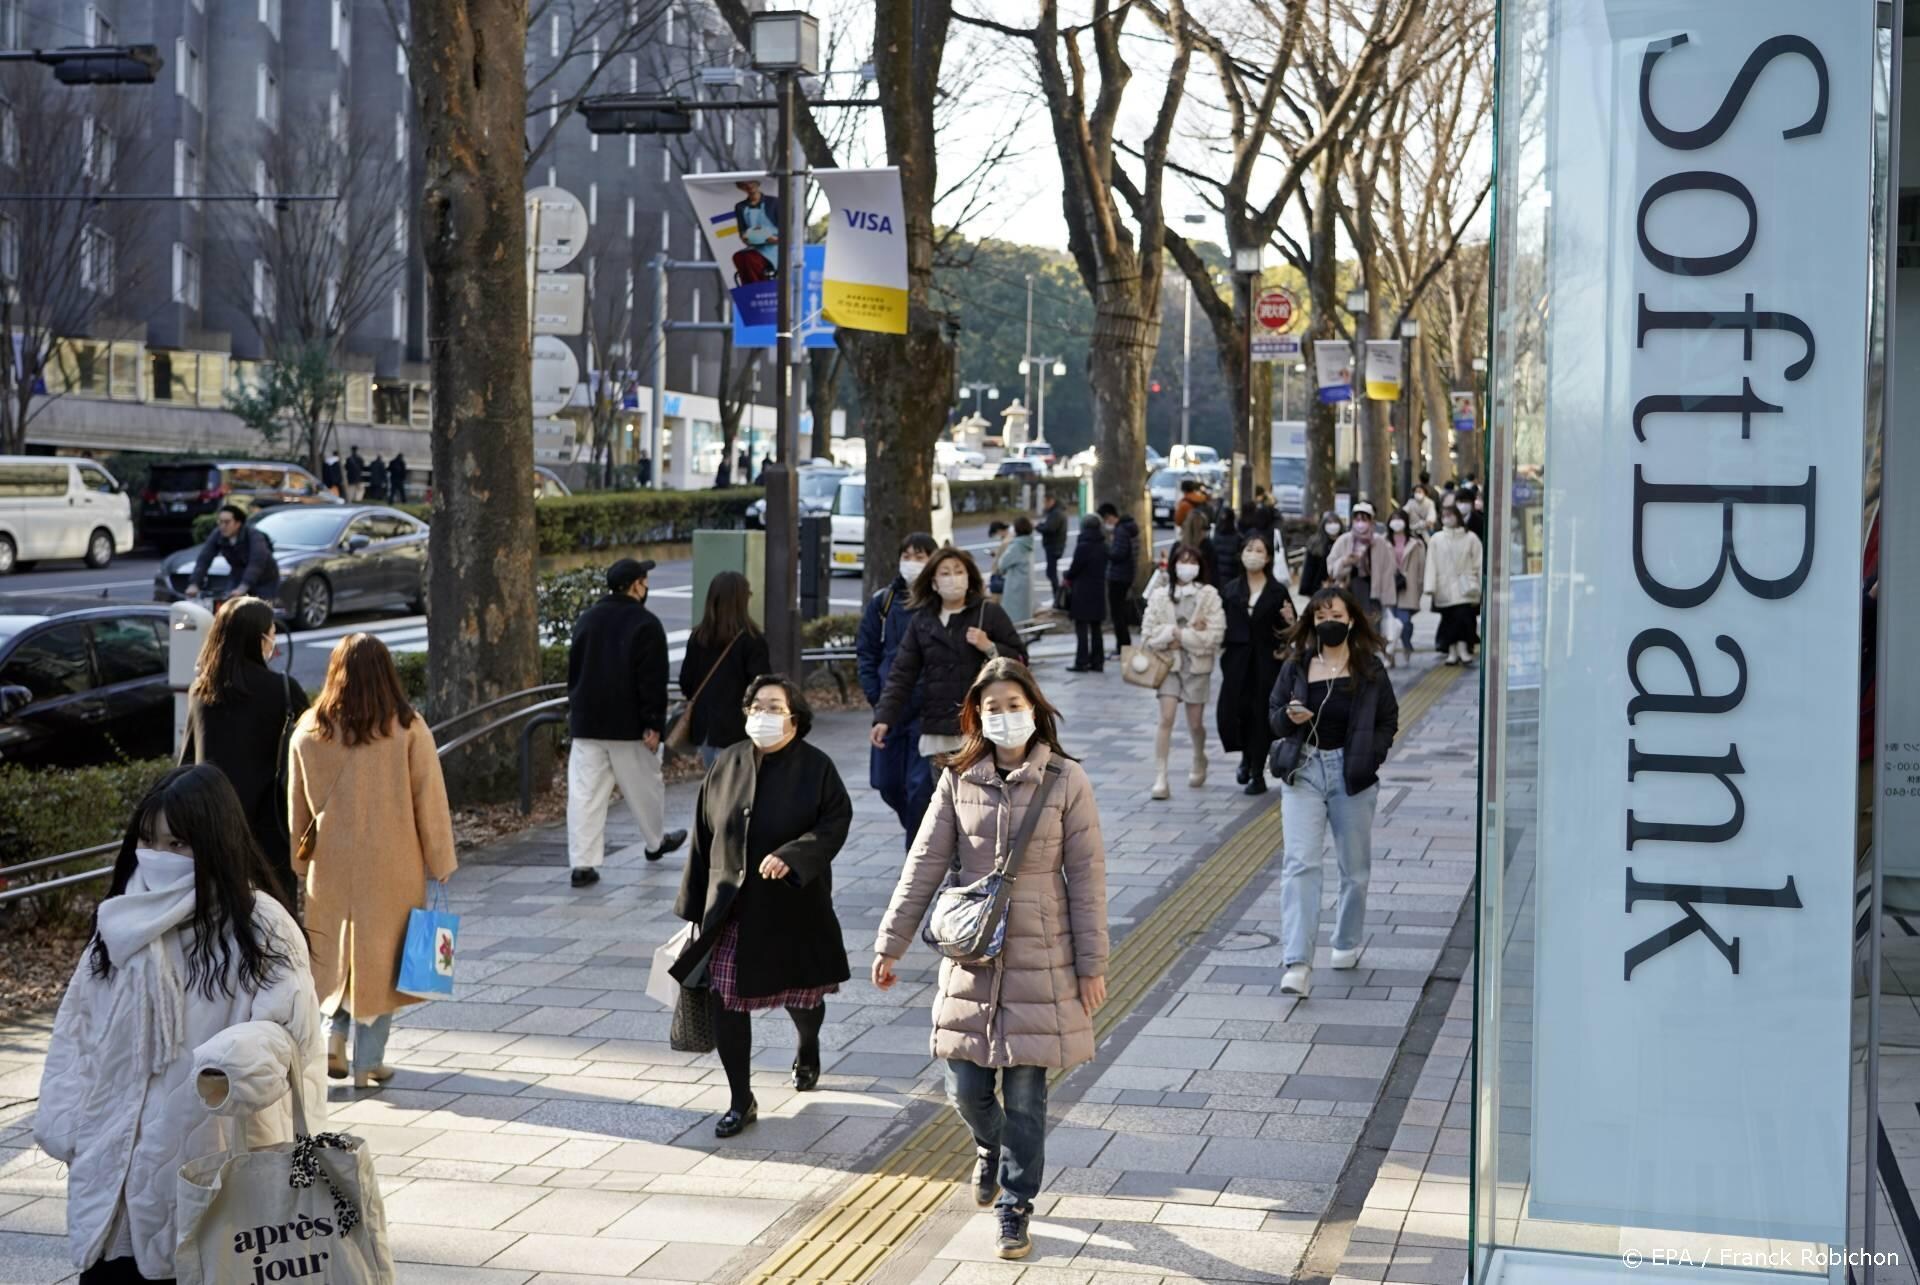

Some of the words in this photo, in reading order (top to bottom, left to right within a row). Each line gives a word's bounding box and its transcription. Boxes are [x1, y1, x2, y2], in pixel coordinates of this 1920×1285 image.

[842, 208, 893, 234] VISA
[1623, 33, 1830, 981] SoftBank
[234, 1213, 334, 1254] après
[251, 1251, 329, 1285] jour
